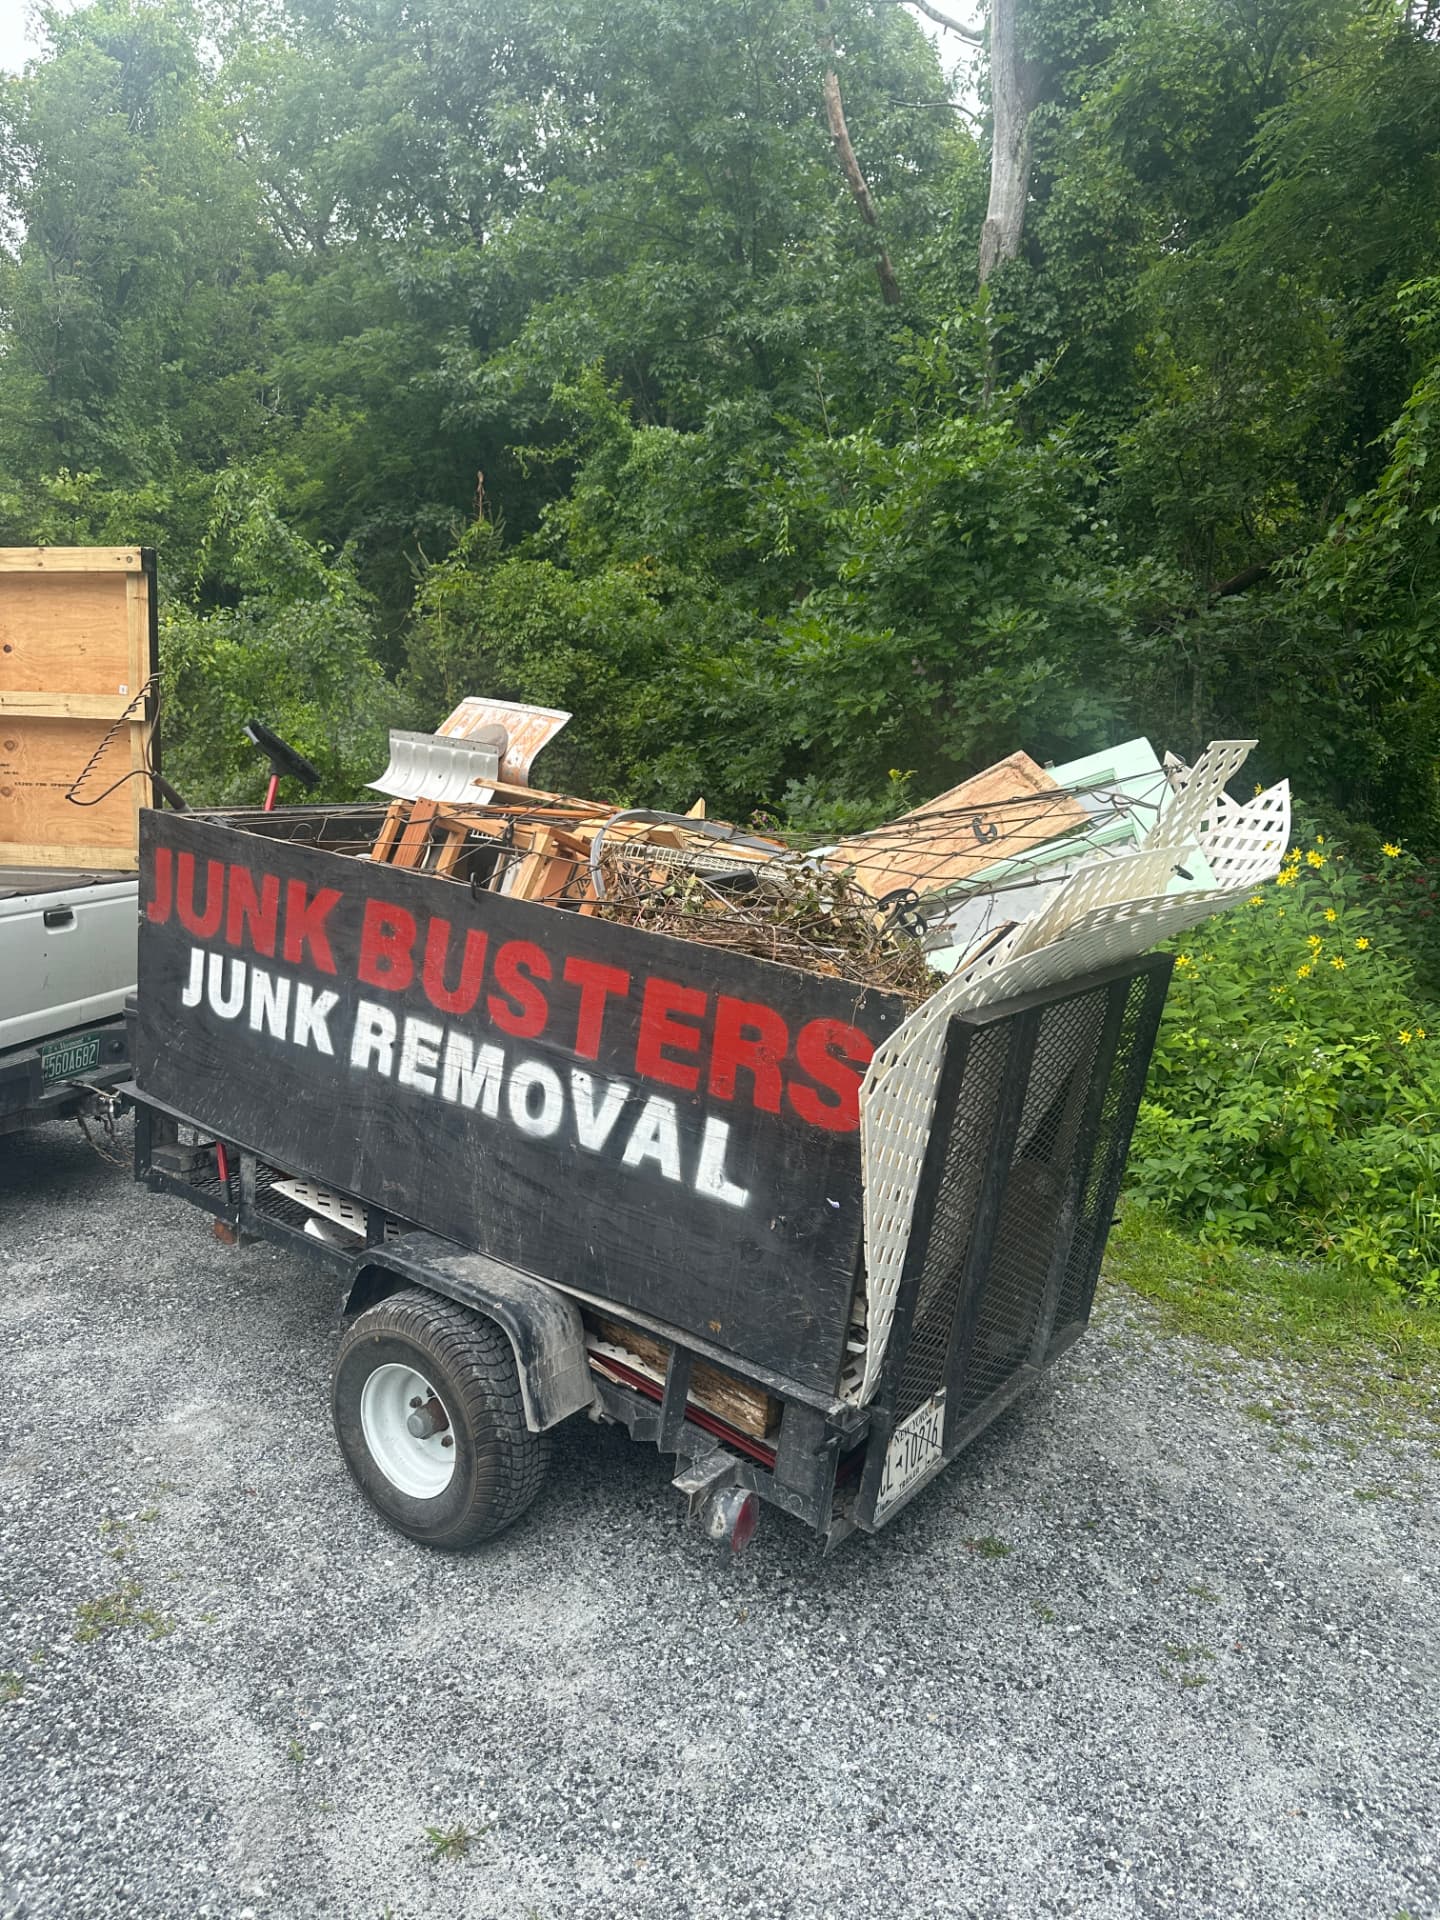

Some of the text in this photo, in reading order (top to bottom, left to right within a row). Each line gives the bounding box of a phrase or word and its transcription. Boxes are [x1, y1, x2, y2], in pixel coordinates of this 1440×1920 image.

[146, 847, 875, 1132] JUNK BUSTERS
[182, 947, 749, 1207] JUNK REMOVAL
